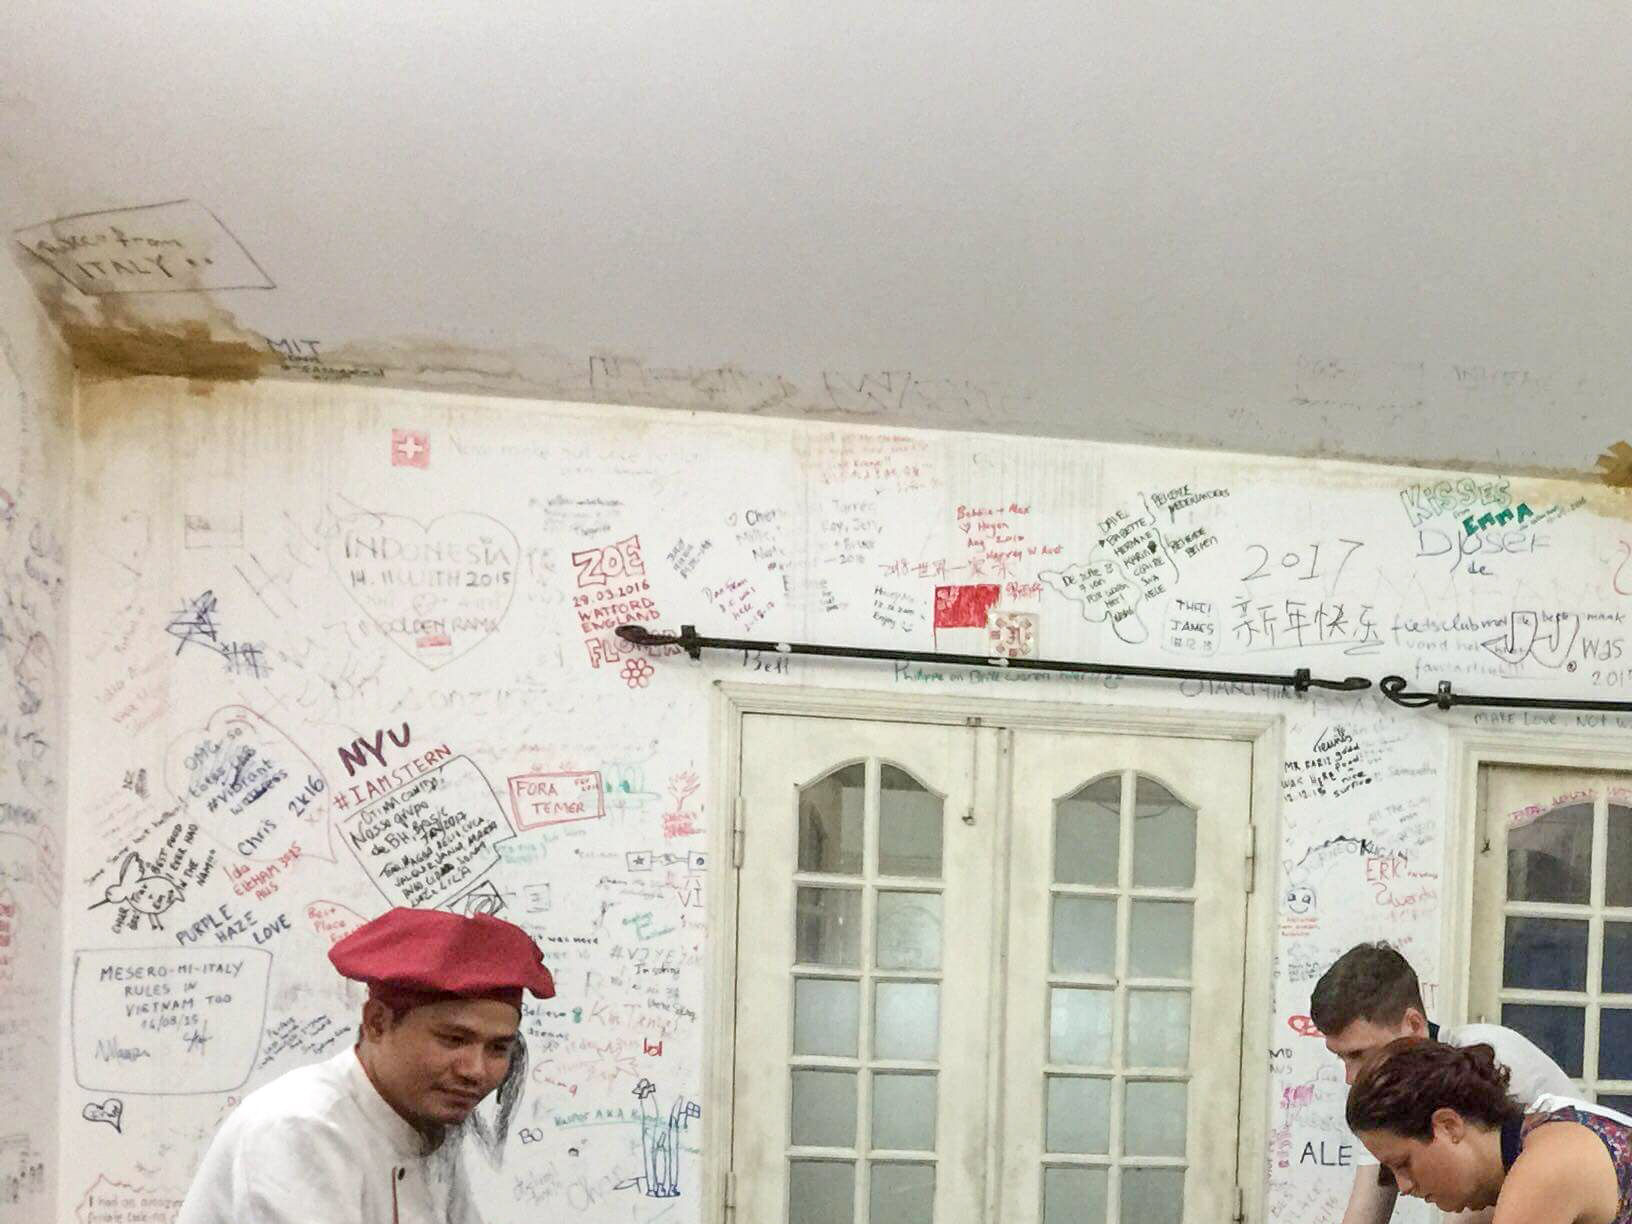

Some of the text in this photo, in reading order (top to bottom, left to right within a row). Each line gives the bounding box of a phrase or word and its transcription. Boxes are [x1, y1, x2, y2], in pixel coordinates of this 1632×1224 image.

[572, 534, 646, 588] ZOE
[1242, 538, 1364, 597] 2017
[577, 597, 656, 623] WATFORD
[581, 609, 661, 635] ENGLAND
[1232, 596, 1379, 648] 新年快乐
[337, 721, 411, 777] NYU
[333, 744, 452, 811] #IAMSTERN
[516, 781, 560, 798] FORA
[531, 801, 586, 817] TEMER
[237, 818, 277, 857] Chris
[176, 904, 233, 946] PURPLE
[215, 910, 259, 944] HAZE
[252, 912, 292, 946] LOVE
[124, 983, 171, 998] RULES
[125, 998, 195, 1018] VIETNAM
